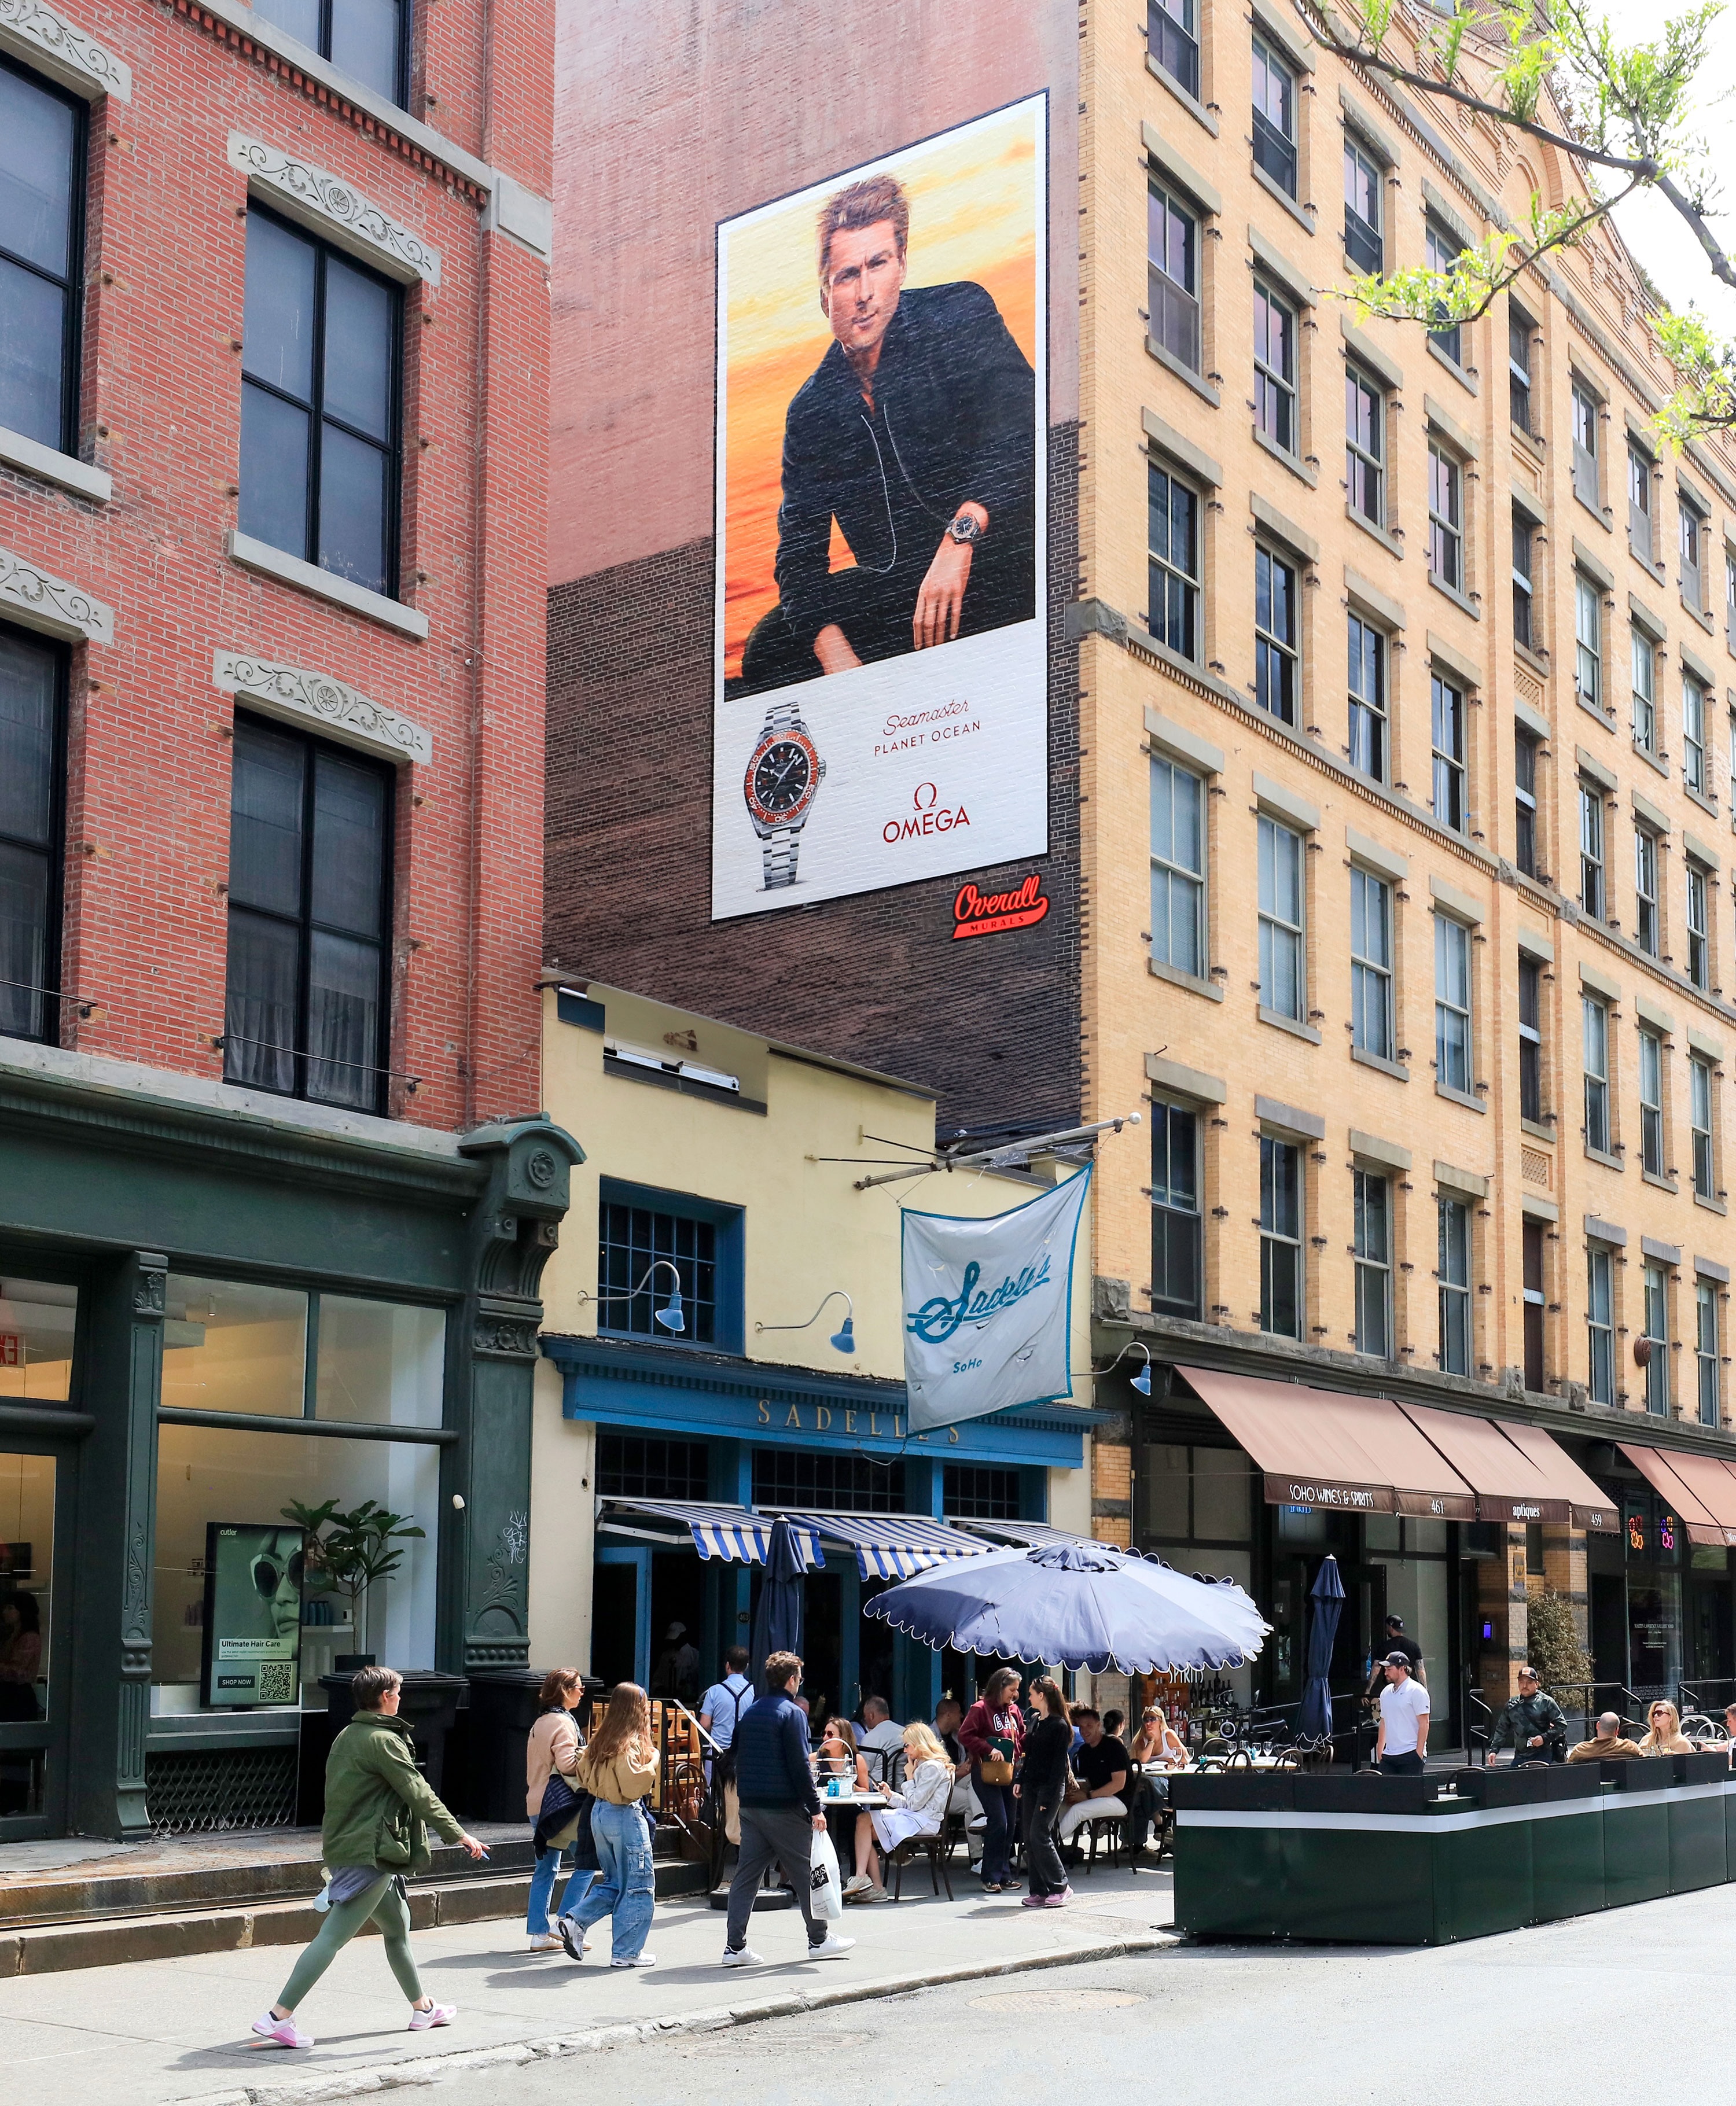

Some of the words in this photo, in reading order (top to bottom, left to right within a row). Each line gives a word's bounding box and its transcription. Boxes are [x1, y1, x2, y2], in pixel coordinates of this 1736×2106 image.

[883, 699, 969, 735] Seamaster
[874, 734, 925, 756] PLANET
[932, 720, 980, 742] OCEAN
[883, 805, 970, 843] OMEGA
[955, 875, 1040, 921] Overall
[970, 915, 1024, 933] MURALS
[953, 1358, 982, 1374] SoHo
[1289, 1483, 1315, 1502] SOHO
[1316, 1488, 1341, 1504] WINES
[1343, 1492, 1349, 1505] &
[1351, 1491, 1374, 1507] SPIRITS
[1431, 1499, 1444, 1514] 461
[1513, 1503, 1540, 1520] aptiques
[1591, 1513, 1602, 1527] 459
